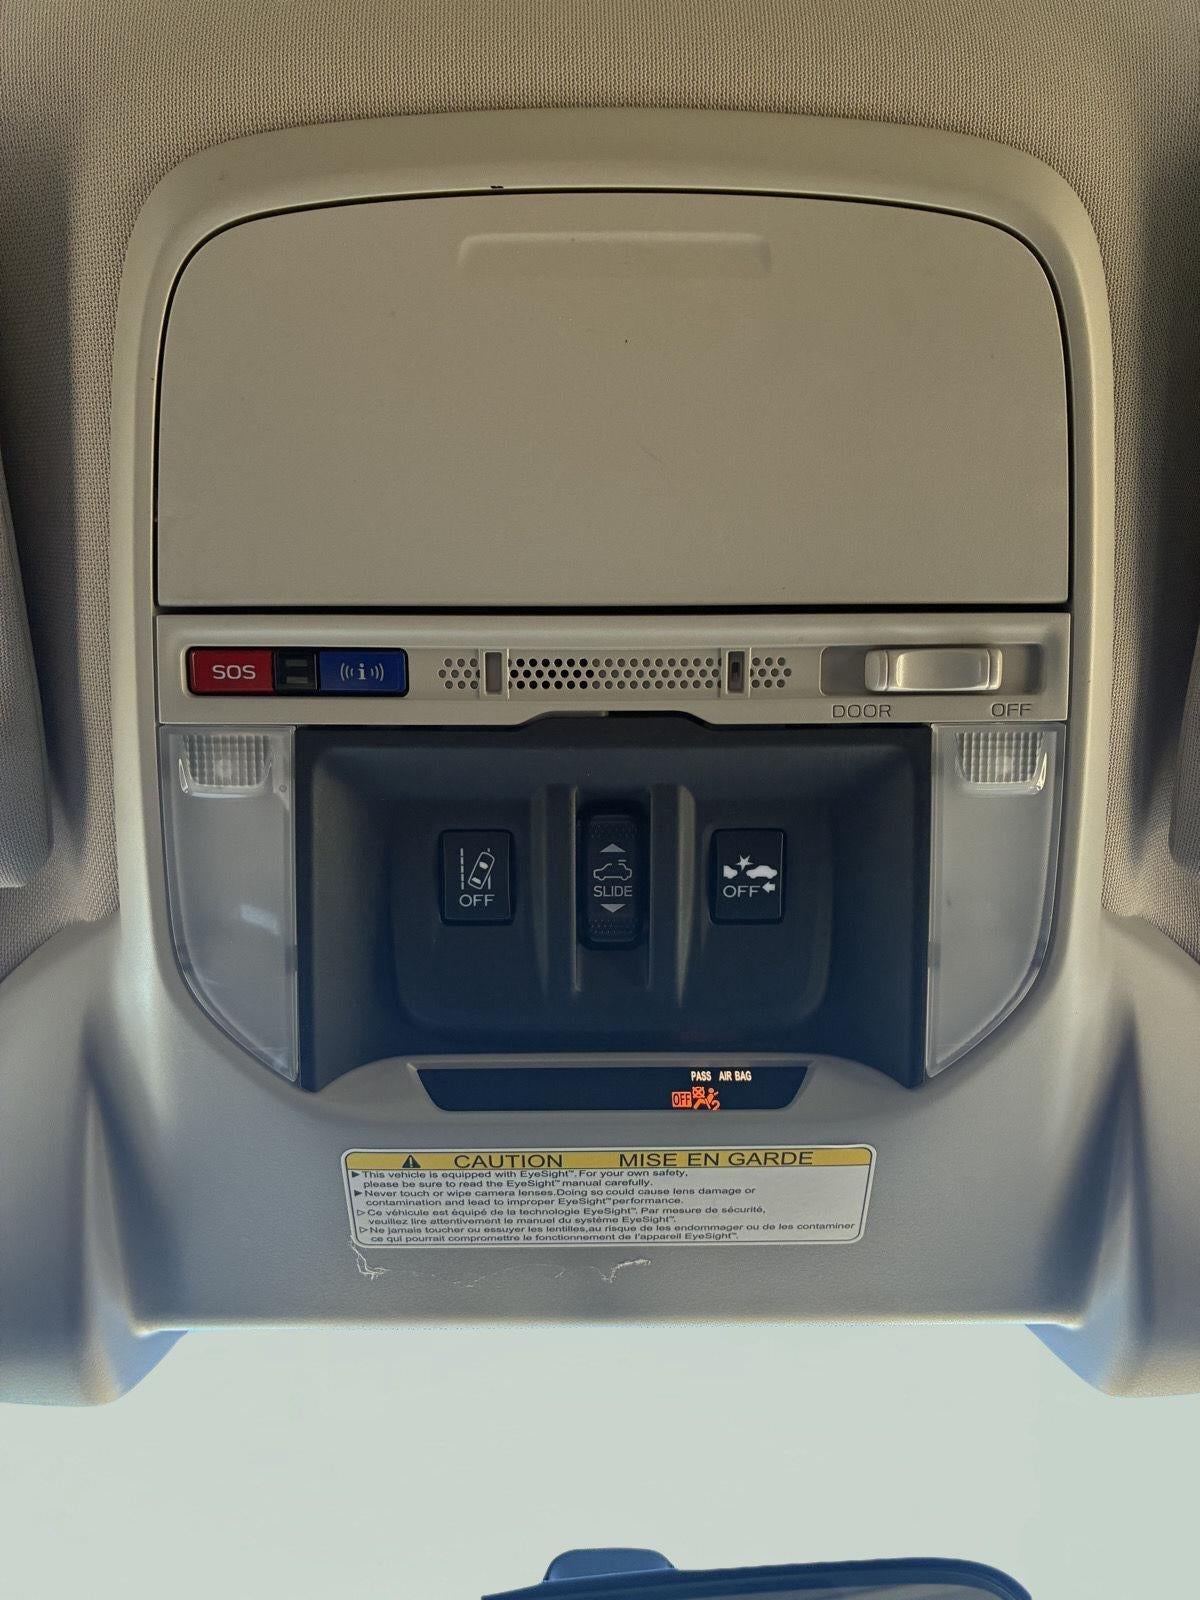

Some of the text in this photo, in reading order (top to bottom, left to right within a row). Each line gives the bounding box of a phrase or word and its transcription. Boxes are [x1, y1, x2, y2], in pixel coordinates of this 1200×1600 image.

[212, 665, 256, 679] SOS
[832, 704, 891, 718] DOOR
[991, 704, 1032, 717] OFF
[594, 886, 632, 897] SLIDE
[723, 886, 760, 898] OFF
[459, 894, 494, 907] OFF
[691, 1071, 752, 1081] PASS AIR BAG
[673, 1093, 690, 1106] OFF
[454, 1154, 563, 1168] CAUTION
[619, 1151, 813, 1167] MISE EN GARDE
[494, 1170, 516, 1178] with
[600, 1170, 623, 1178] your
[363, 1181, 399, 1189] please
[459, 1180, 483, 1188] read
[562, 1179, 602, 1187] manual
[605, 1179, 653, 1187] carefully.
[447, 1190, 472, 1198] wipe
[606, 1188, 635, 1196] could
[698, 1188, 742, 1196] damage
[507, 1198, 555, 1207] improper
[386, 1208, 429, 1216] véhicule
[452, 1208, 487, 1217] équipé
[519, 1208, 580, 1216] technologie
[430, 1217, 501, 1225] attentivement
[388, 1226, 422, 1235] jamais
[484, 1226, 525, 1234] essuyer
[605, 1225, 637, 1233] risque
[640, 1224, 653, 1232] de
[674, 1224, 744, 1232] endommager
[797, 1222, 855, 1230] contaminer
[387, 1235, 402, 1243] qui
[405, 1235, 445, 1243] pourrait
[448, 1234, 520, 1243] compromettre
[535, 1233, 615, 1241] fonctionnement
